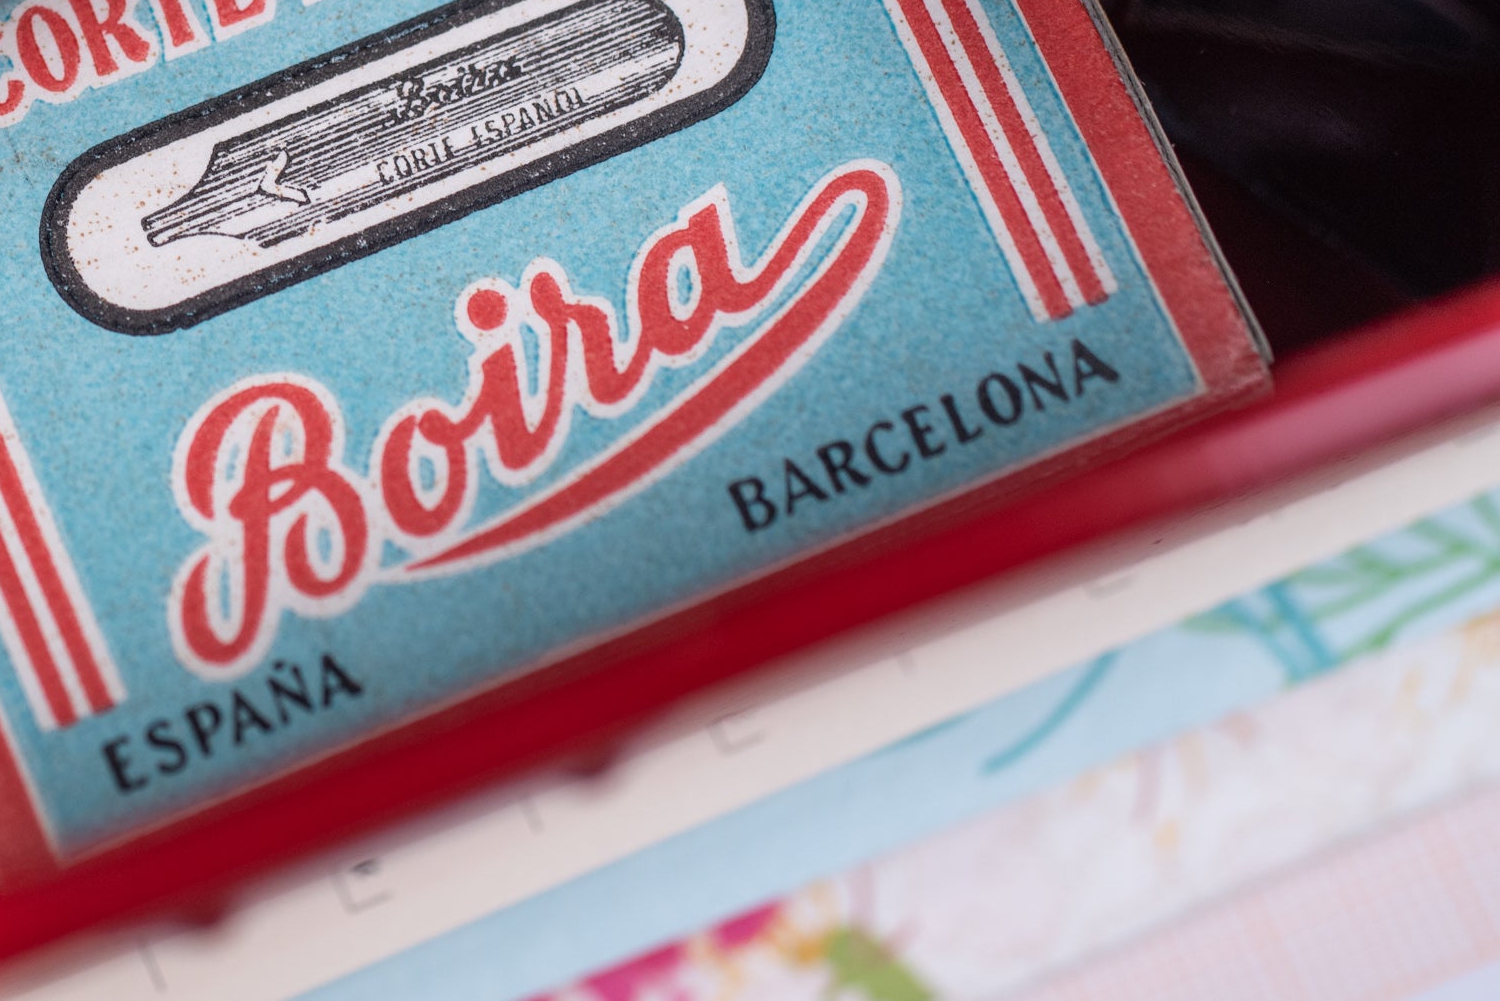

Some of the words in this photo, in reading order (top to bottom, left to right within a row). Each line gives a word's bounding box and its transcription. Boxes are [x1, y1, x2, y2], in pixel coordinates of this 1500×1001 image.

[102, 652, 365, 794] ESPAÑA
[727, 338, 1121, 532] BARCELONA
[180, 168, 892, 668] Boira
